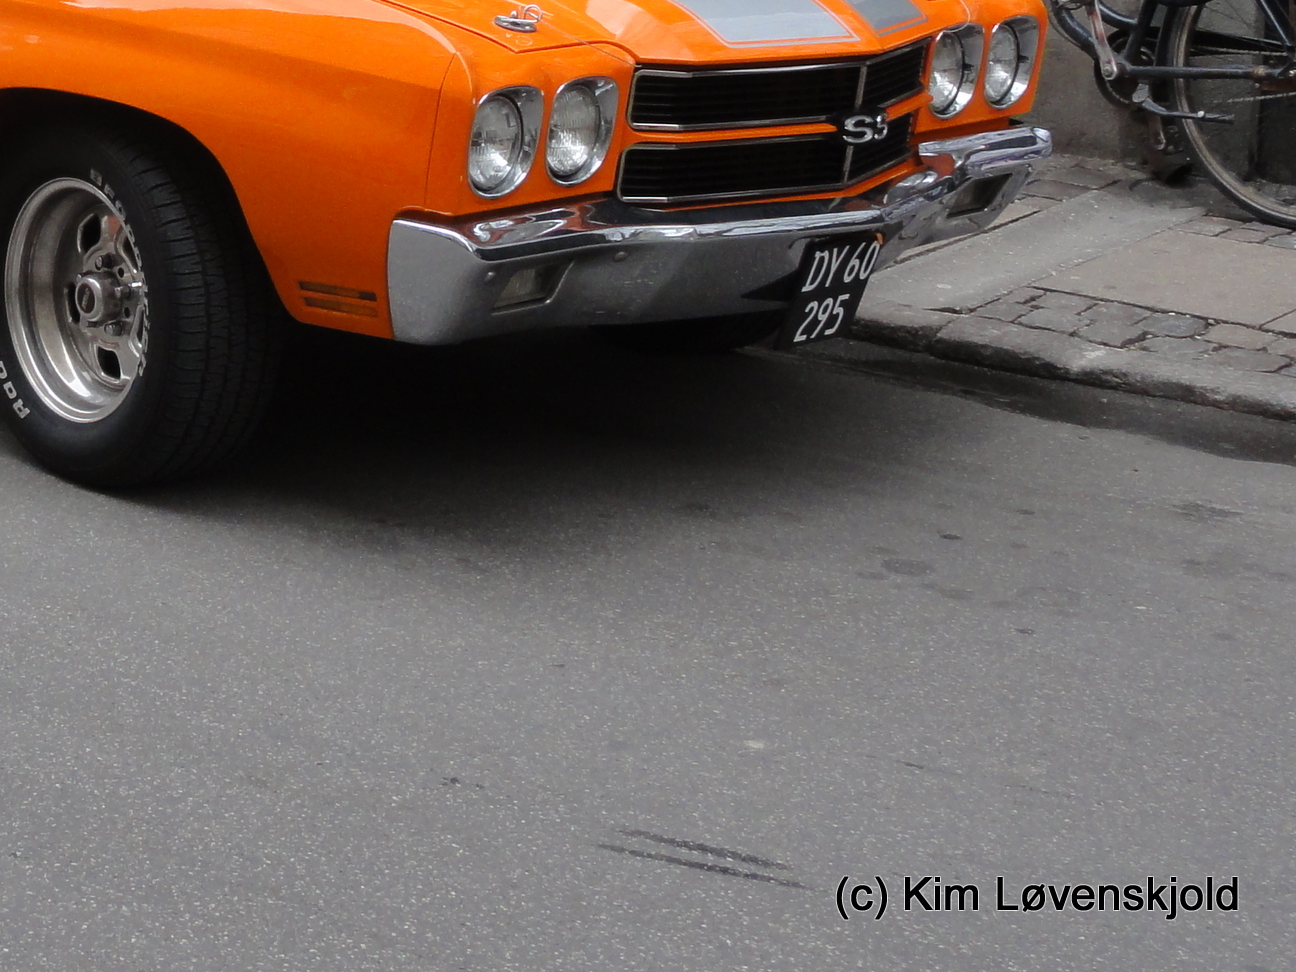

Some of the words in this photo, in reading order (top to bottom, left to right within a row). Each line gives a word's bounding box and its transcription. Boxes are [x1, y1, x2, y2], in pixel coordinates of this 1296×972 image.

[801, 245, 850, 293] DY
[843, 239, 881, 284] 60
[793, 293, 851, 343] 295
